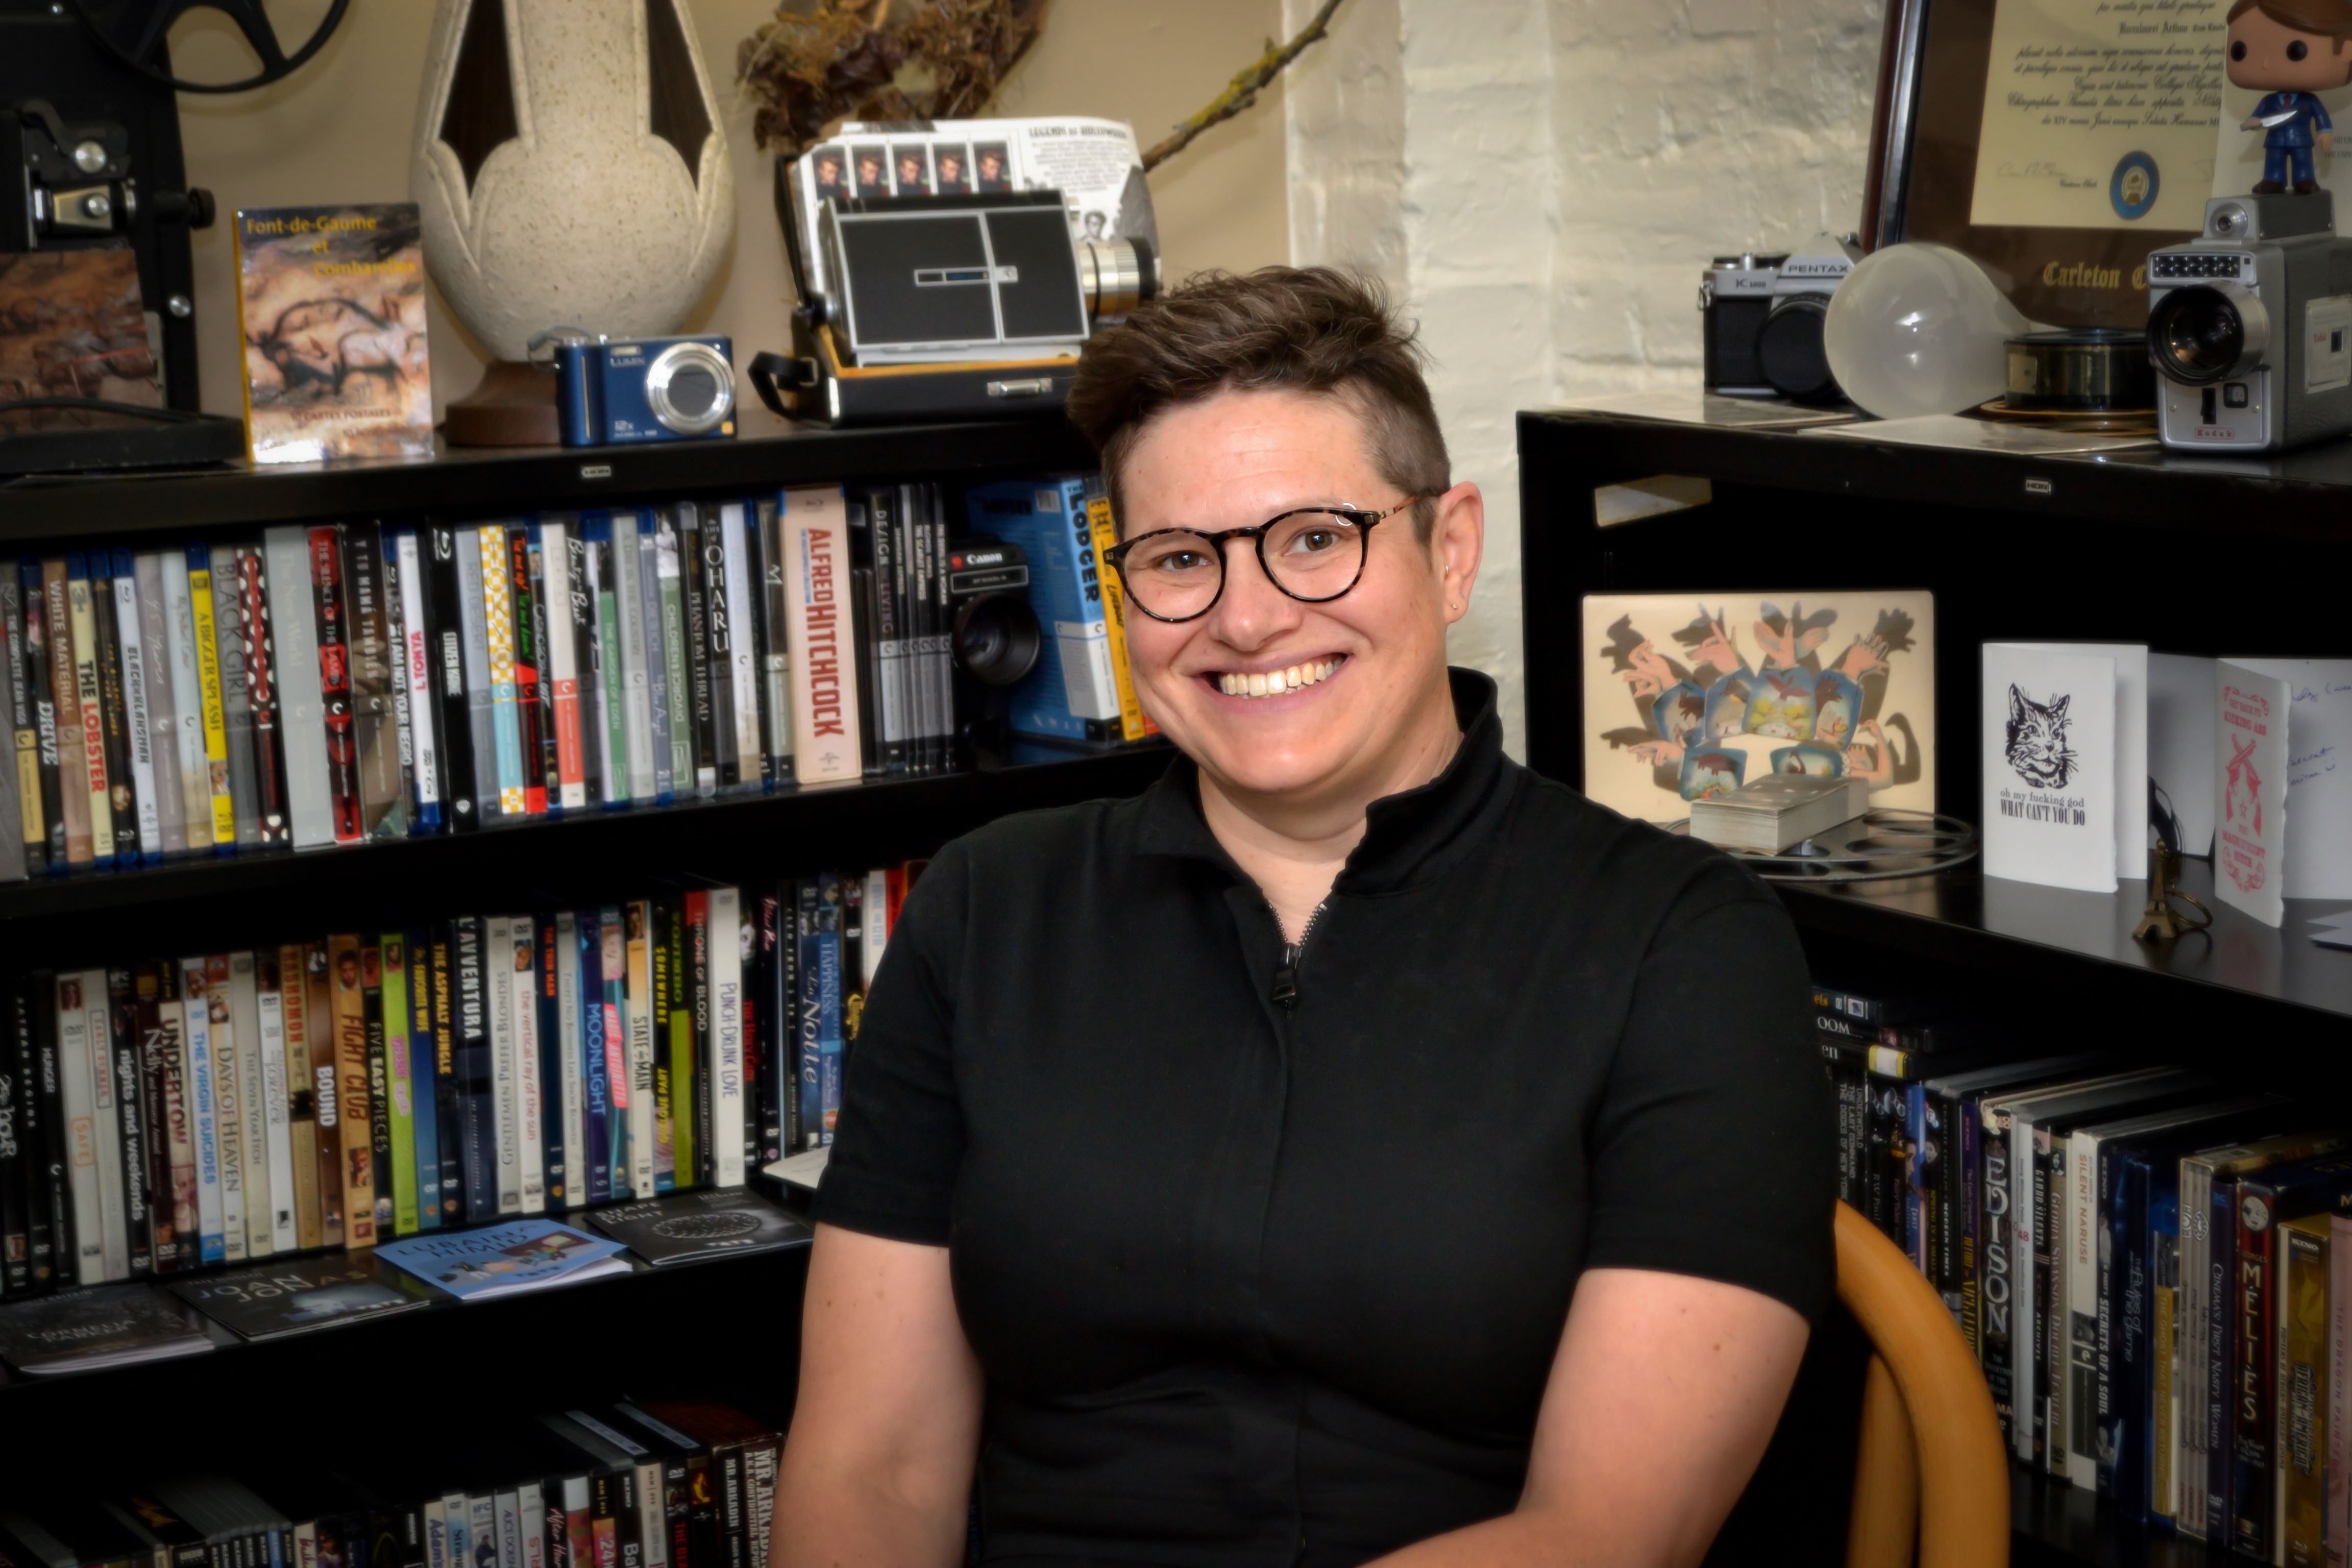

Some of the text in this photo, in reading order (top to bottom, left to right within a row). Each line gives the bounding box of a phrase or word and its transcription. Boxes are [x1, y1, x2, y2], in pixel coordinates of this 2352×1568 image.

[247, 215, 378, 235] Font-de-Gaume
[312, 240, 329, 254] et
[314, 258, 416, 277] Combarelles
[1788, 264, 1848, 273] PENTAX
[2042, 261, 2122, 291] Carleton
[2196, 429, 2232, 438] Kodak
[765, 563, 783, 585] M
[875, 509, 893, 634] DESIGN LIVING
[966, 552, 1003, 566] Canon
[1069, 493, 1100, 602] LODGER
[517, 592, 531, 607] Tie
[50, 580, 74, 716] WHITE MATERIAL
[201, 624, 215, 676] BIGGER
[216, 564, 247, 703] BLACK GIRL
[391, 643, 404, 664] AM
[442, 631, 462, 696] CITIZEN KANE
[520, 626, 535, 661] down!
[690, 592, 710, 722] PHANTOM THREAD
[806, 528, 845, 738] ALFRED HITCHCOCK
[206, 679, 220, 730] SPLASH
[393, 666, 407, 689] NOT
[396, 693, 410, 725] YOUR
[37, 700, 59, 766] DRIVE
[79, 661, 106, 793] THE LOBSTER
[398, 726, 413, 766] NEGRO
[2224, 710, 2252, 733] KICKING
[2000, 788, 2085, 808] oh my fucking god
[2000, 798, 2086, 826] WHAT CAN'T YOU DO
[458, 916, 482, 1039] L'AVVENTURA
[543, 926, 556, 996] THE THIN MAN
[655, 946, 669, 1025] SOMEWHERE
[692, 911, 708, 1032] THRONE OF BLOOD
[821, 943, 834, 1015] HAPPINESS
[433, 944, 452, 1075] THE ASPHALT JUNGLE
[720, 982, 740, 1099] PUNCH-DRUNK LOVE
[801, 996, 821, 1084] Notte
[41, 1047, 56, 1094] HUNGER
[161, 1017, 188, 1145] UNDERTOW
[341, 1014, 370, 1121] FIGHT CLUB
[497, 971, 516, 1166] GENTLEMEN PREFER BLONDES
[521, 990, 537, 1141] the vertical ray of the sun
[586, 1002, 606, 1117] MOONLIGHT
[632, 1016, 651, 1092] STATE MAIN
[193, 1032, 217, 1185] THE VIRGIN SUICIDES
[216, 1047, 241, 1193] DAYS OF HEAVEN
[244, 1051, 263, 1166] THE SEVEN YEAR ITCH
[315, 1065, 337, 1128] BOUND
[367, 1021, 389, 1154] FIVE EASY PIECES
[75, 1123, 89, 1160] SAFE
[117, 1048, 146, 1221] nights and weekends
[1840, 1083, 1849, 1200] THE DOCKS OF NEW YORK
[1848, 1085, 1857, 1179] THE LAST COMMAND
[1984, 1153, 2010, 1335] EDISON
[2017, 1229, 2029, 1242] 48
[2079, 1207, 2088, 1265] NARUSE
[2291, 1237, 2319, 1255] KINO
[2050, 1192, 2063, 1426] GLORIA SWANSON DOUBLE FEATURE
[2098, 1297, 2110, 1352] SECRETS
[2130, 1271, 2143, 1315] Rules
[2134, 1317, 2143, 1332] of
[2122, 1290, 2136, 1363] the game
[2210, 1263, 2224, 1449] CINEMA'S FIRST NASTY WOMEN
[2279, 1327, 2287, 1362] PIONEERS
[2099, 1354, 2110, 1369] OF
[2099, 1371, 2110, 1383] A
[2279, 1363, 2287, 1373] OF
[2332, 1306, 2343, 1468] THE DRAGON PAINTER
[2098, 1383, 2110, 1414] SOUL
[2278, 1374, 2287, 1441] AFRICAN-AMERICAN
[2296, 1363, 2310, 1473] AFRICAN-AMERICAN
[429, 1519, 446, 1568] Adam's
[453, 1529, 466, 1568] Strang
[599, 1537, 616, 1561] 24
